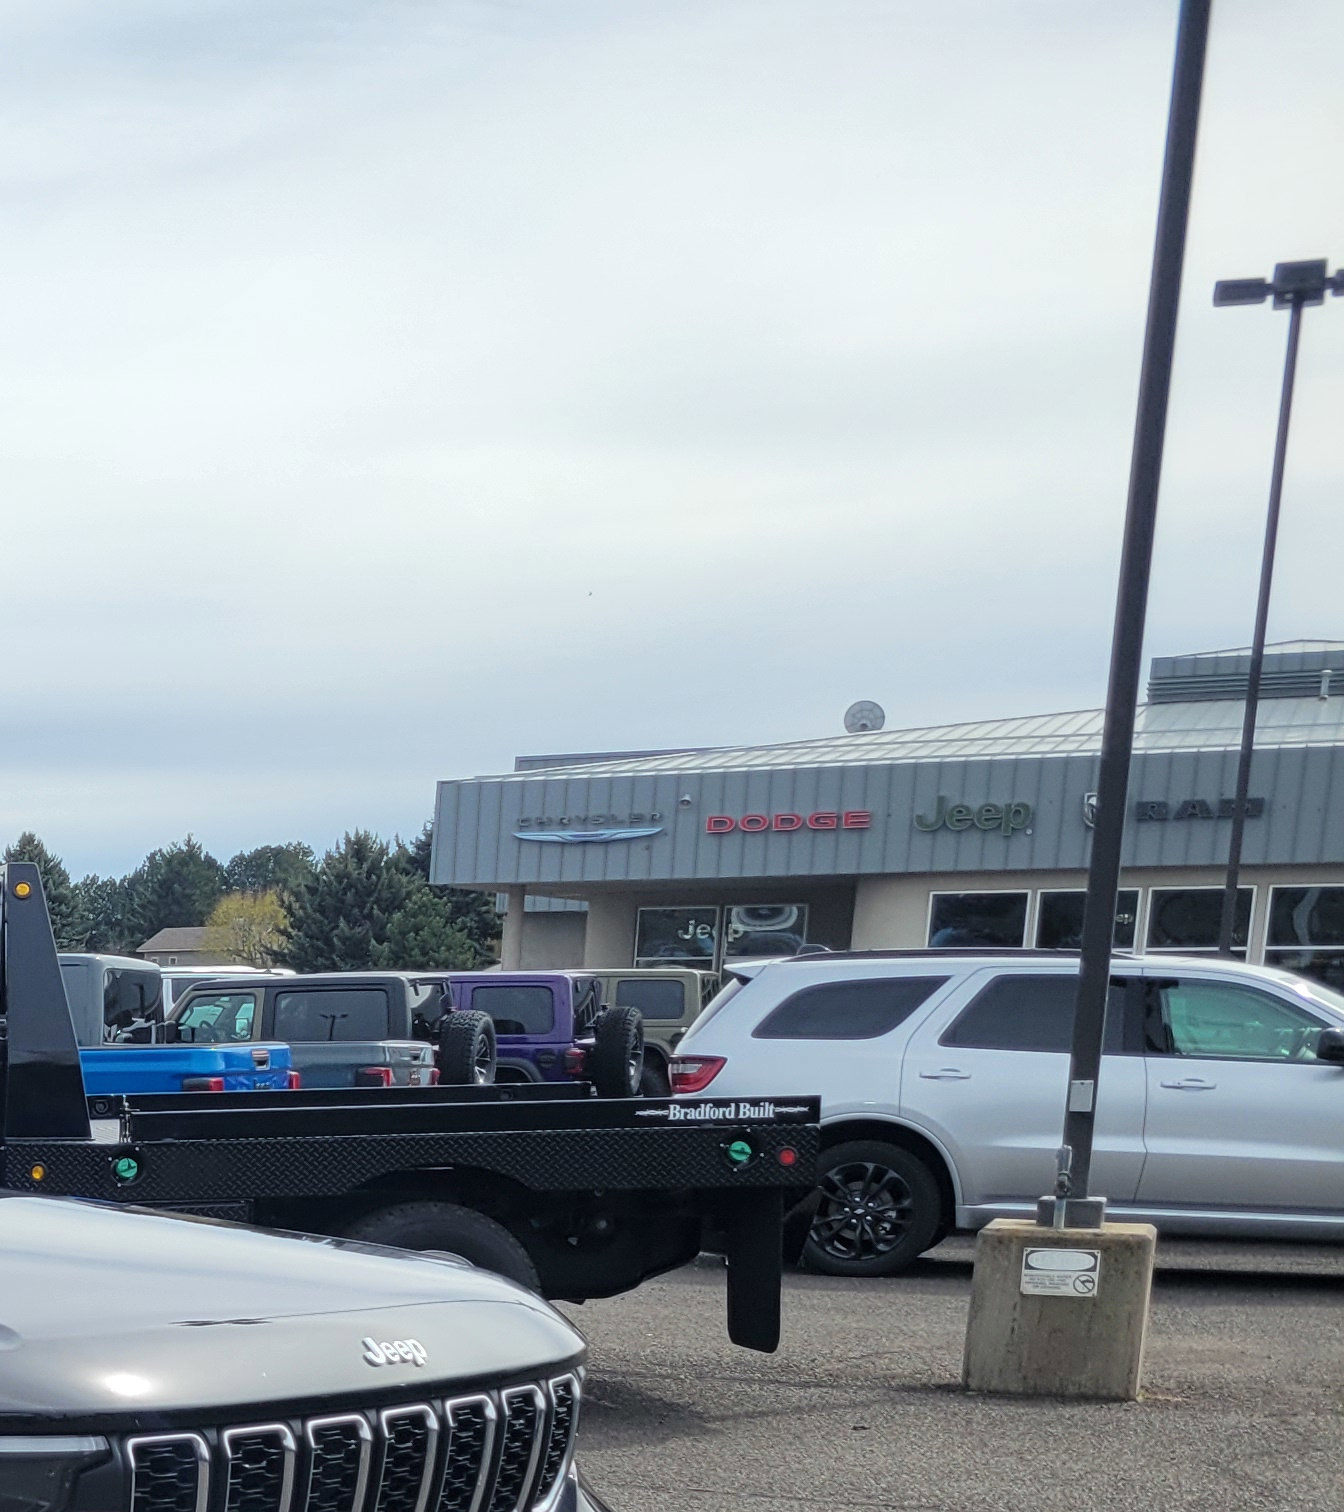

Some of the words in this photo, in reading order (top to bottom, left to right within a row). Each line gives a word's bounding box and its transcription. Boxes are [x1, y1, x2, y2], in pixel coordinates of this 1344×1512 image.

[518, 812, 663, 828] CHRYSLER
[915, 795, 1033, 836] Jeep
[1136, 797, 1265, 822] RAM
[705, 810, 872, 834] DODGE
[678, 919, 744, 943] Jep
[668, 1103, 736, 1121] Bradford
[738, 1102, 775, 1119] Built
[361, 1336, 428, 1367] Jeep
